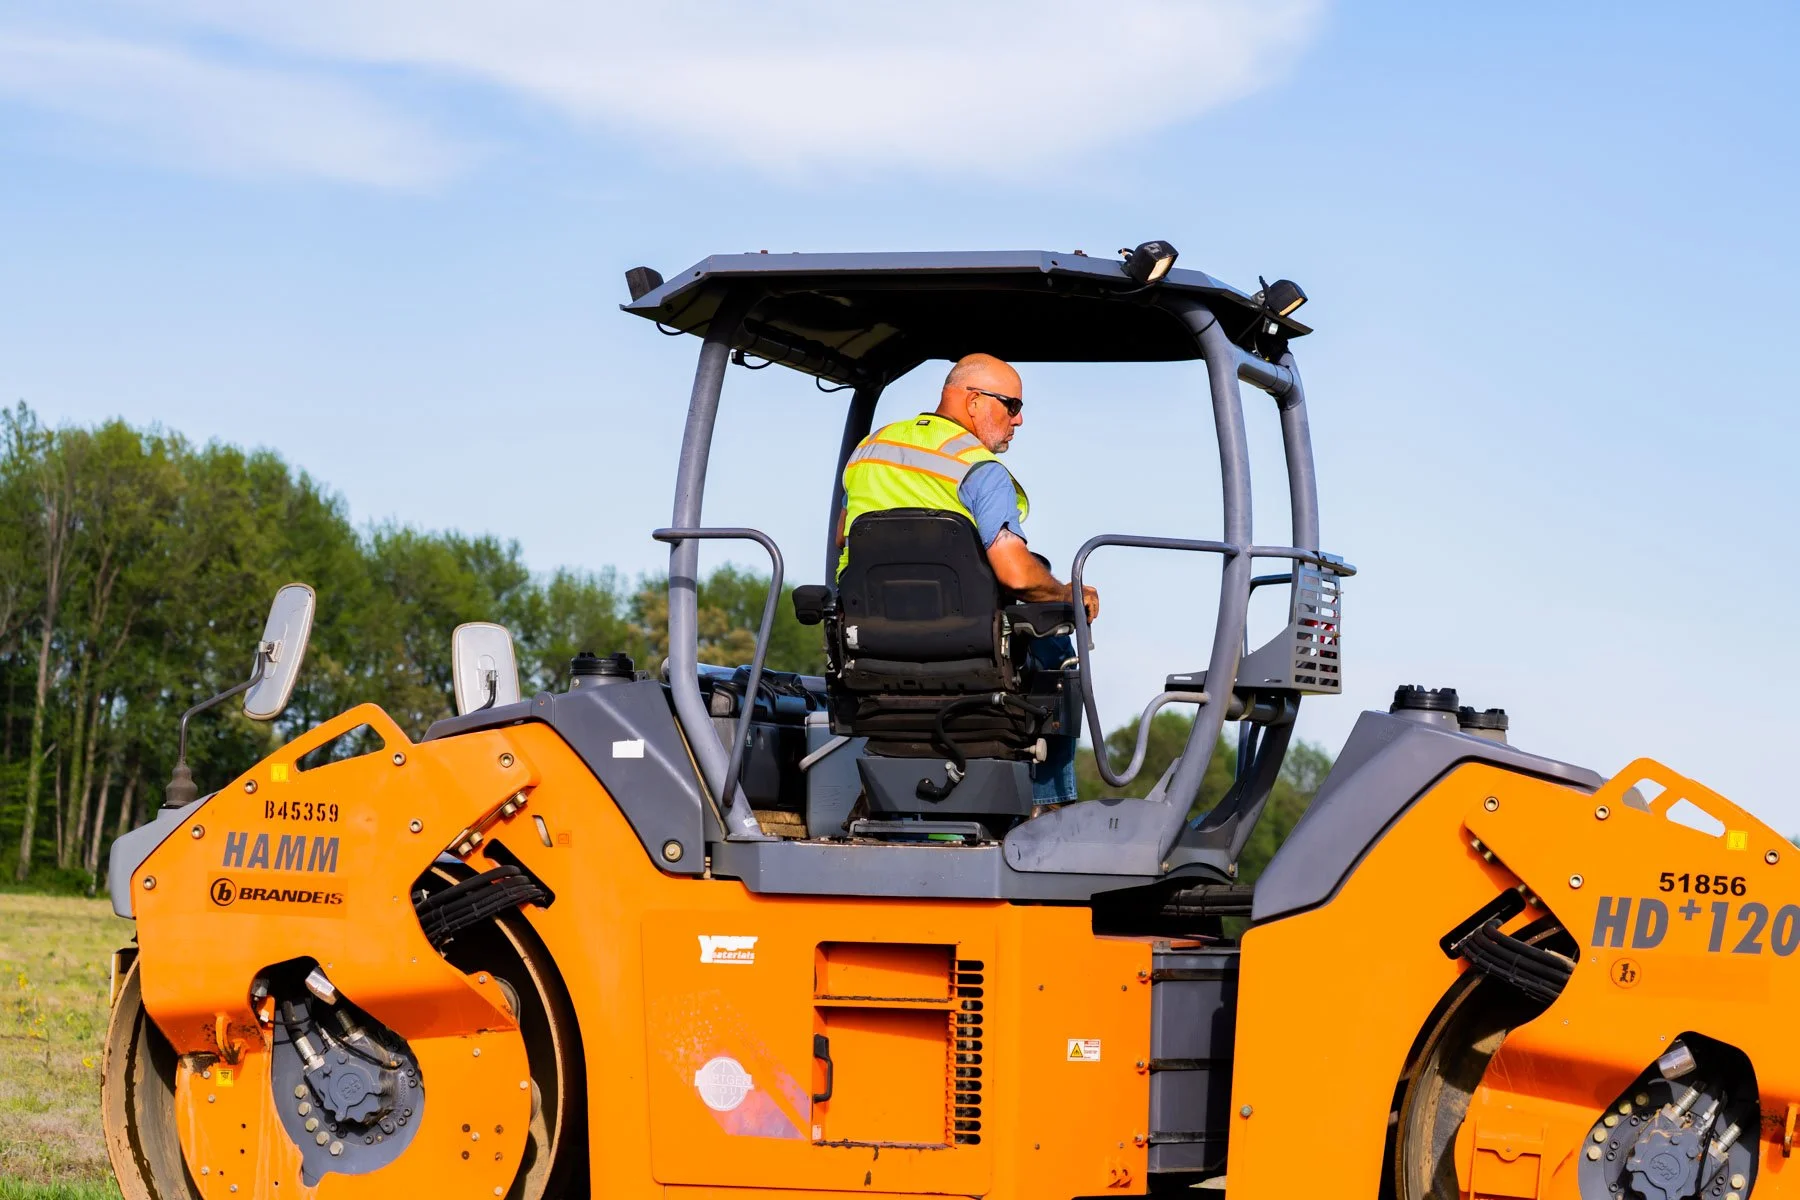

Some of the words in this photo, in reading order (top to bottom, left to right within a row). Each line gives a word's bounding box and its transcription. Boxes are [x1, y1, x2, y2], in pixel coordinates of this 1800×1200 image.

[265, 800, 339, 822] B45359
[222, 832, 340, 873] HAMM
[1659, 872, 1747, 896] 51856
[239, 887, 344, 905] BRANDEIS
